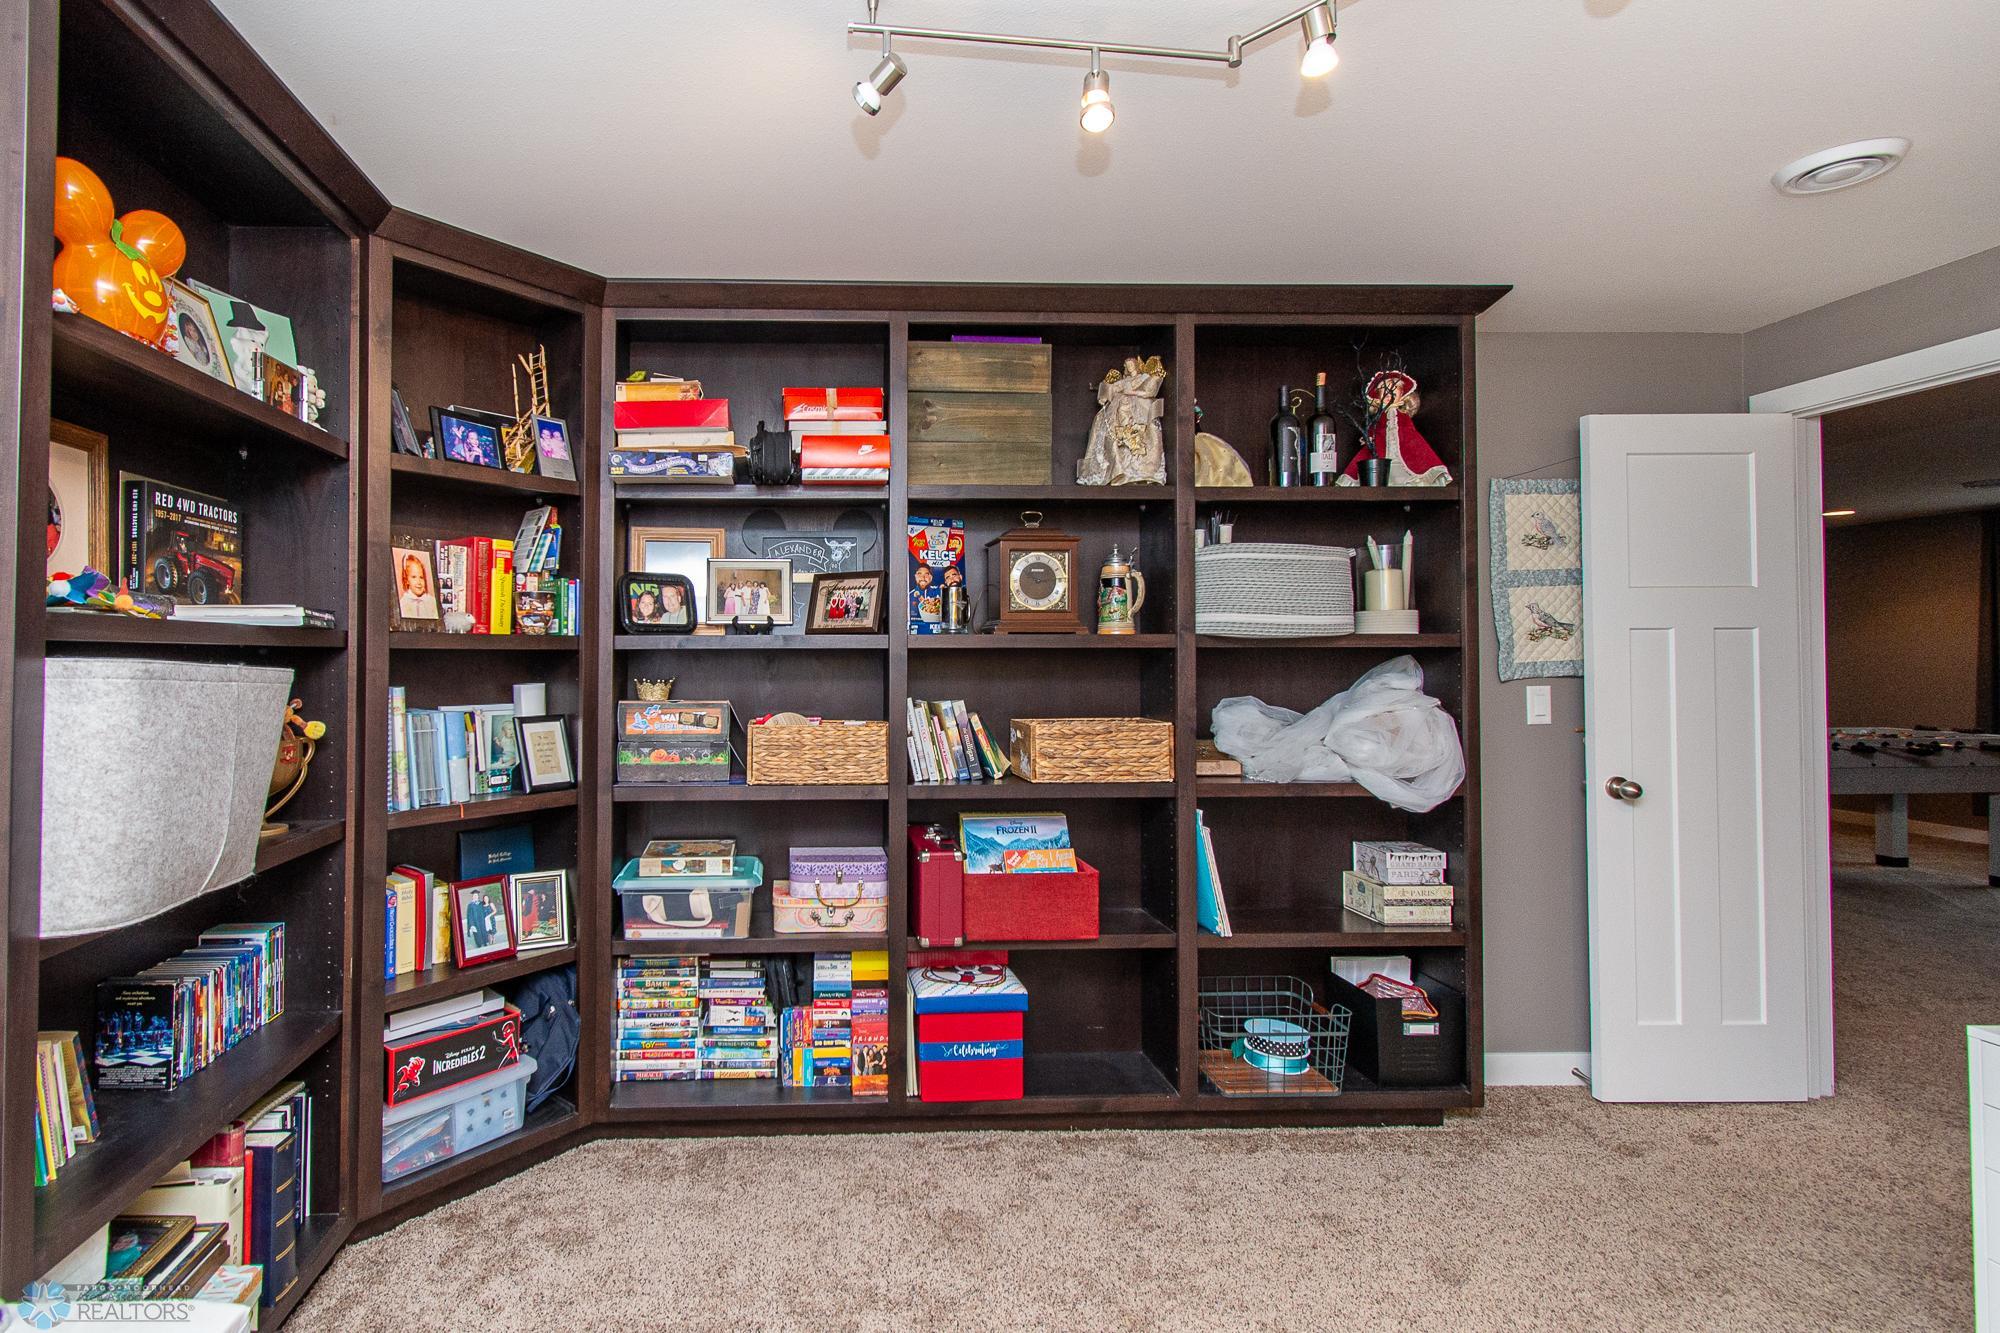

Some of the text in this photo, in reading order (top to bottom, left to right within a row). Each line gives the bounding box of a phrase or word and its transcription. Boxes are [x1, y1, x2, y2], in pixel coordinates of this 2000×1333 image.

[155, 491, 238, 524] RED 4WD TRACTORS
[774, 544, 823, 558] ALEXANDER
[919, 549, 957, 562] KELCE
[819, 579, 876, 597] Family
[963, 734, 976, 762] mulligan
[996, 825, 1037, 835] FROZEN II
[1391, 870, 1419, 878] PARIS
[1410, 889, 1436, 897] PARIS
[645, 979, 670, 987] BAMBI
[445, 1046, 476, 1059] Disney PIXAR
[953, 1042, 998, 1058] Celebrating
[432, 1045, 486, 1076] INCREDIBLES 2
